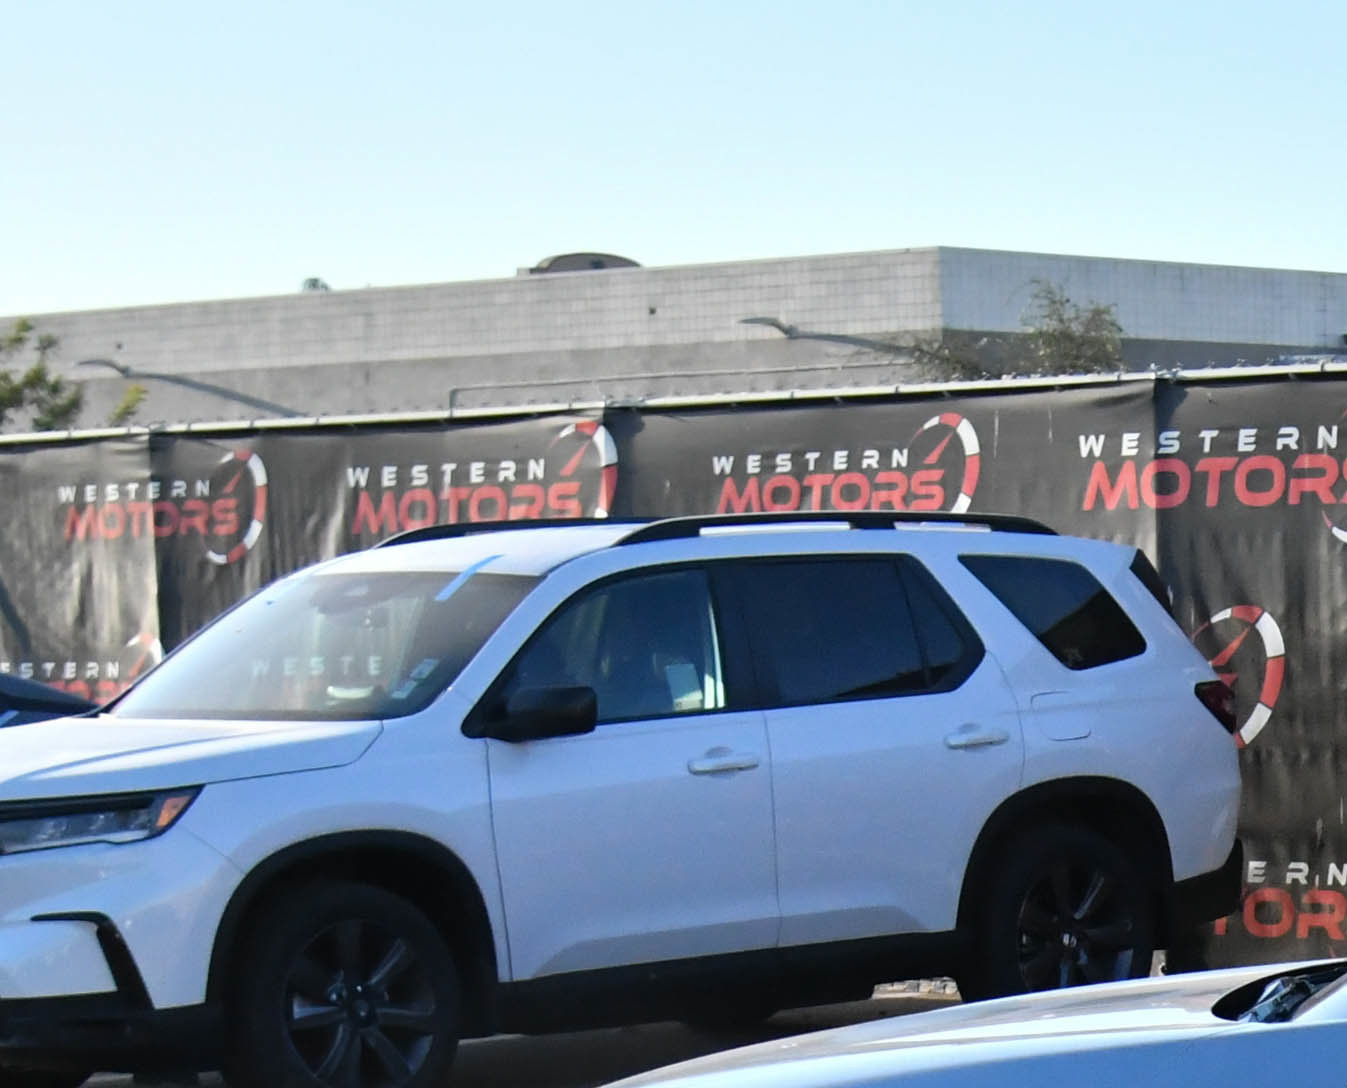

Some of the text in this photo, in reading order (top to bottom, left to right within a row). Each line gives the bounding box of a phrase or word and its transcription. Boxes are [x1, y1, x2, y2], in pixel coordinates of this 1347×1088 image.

[1078, 425, 1338, 458] WESTERN
[347, 458, 545, 488] WESTERN
[712, 448, 909, 475] WESTERN
[58, 480, 210, 503] WESTERN
[716, 469, 945, 514] MOTORS
[64, 498, 240, 544] MOTORS
[352, 482, 582, 535] MOTORS
[0, 661, 120, 679] ESTERN
[253, 656, 384, 678] WESTE
